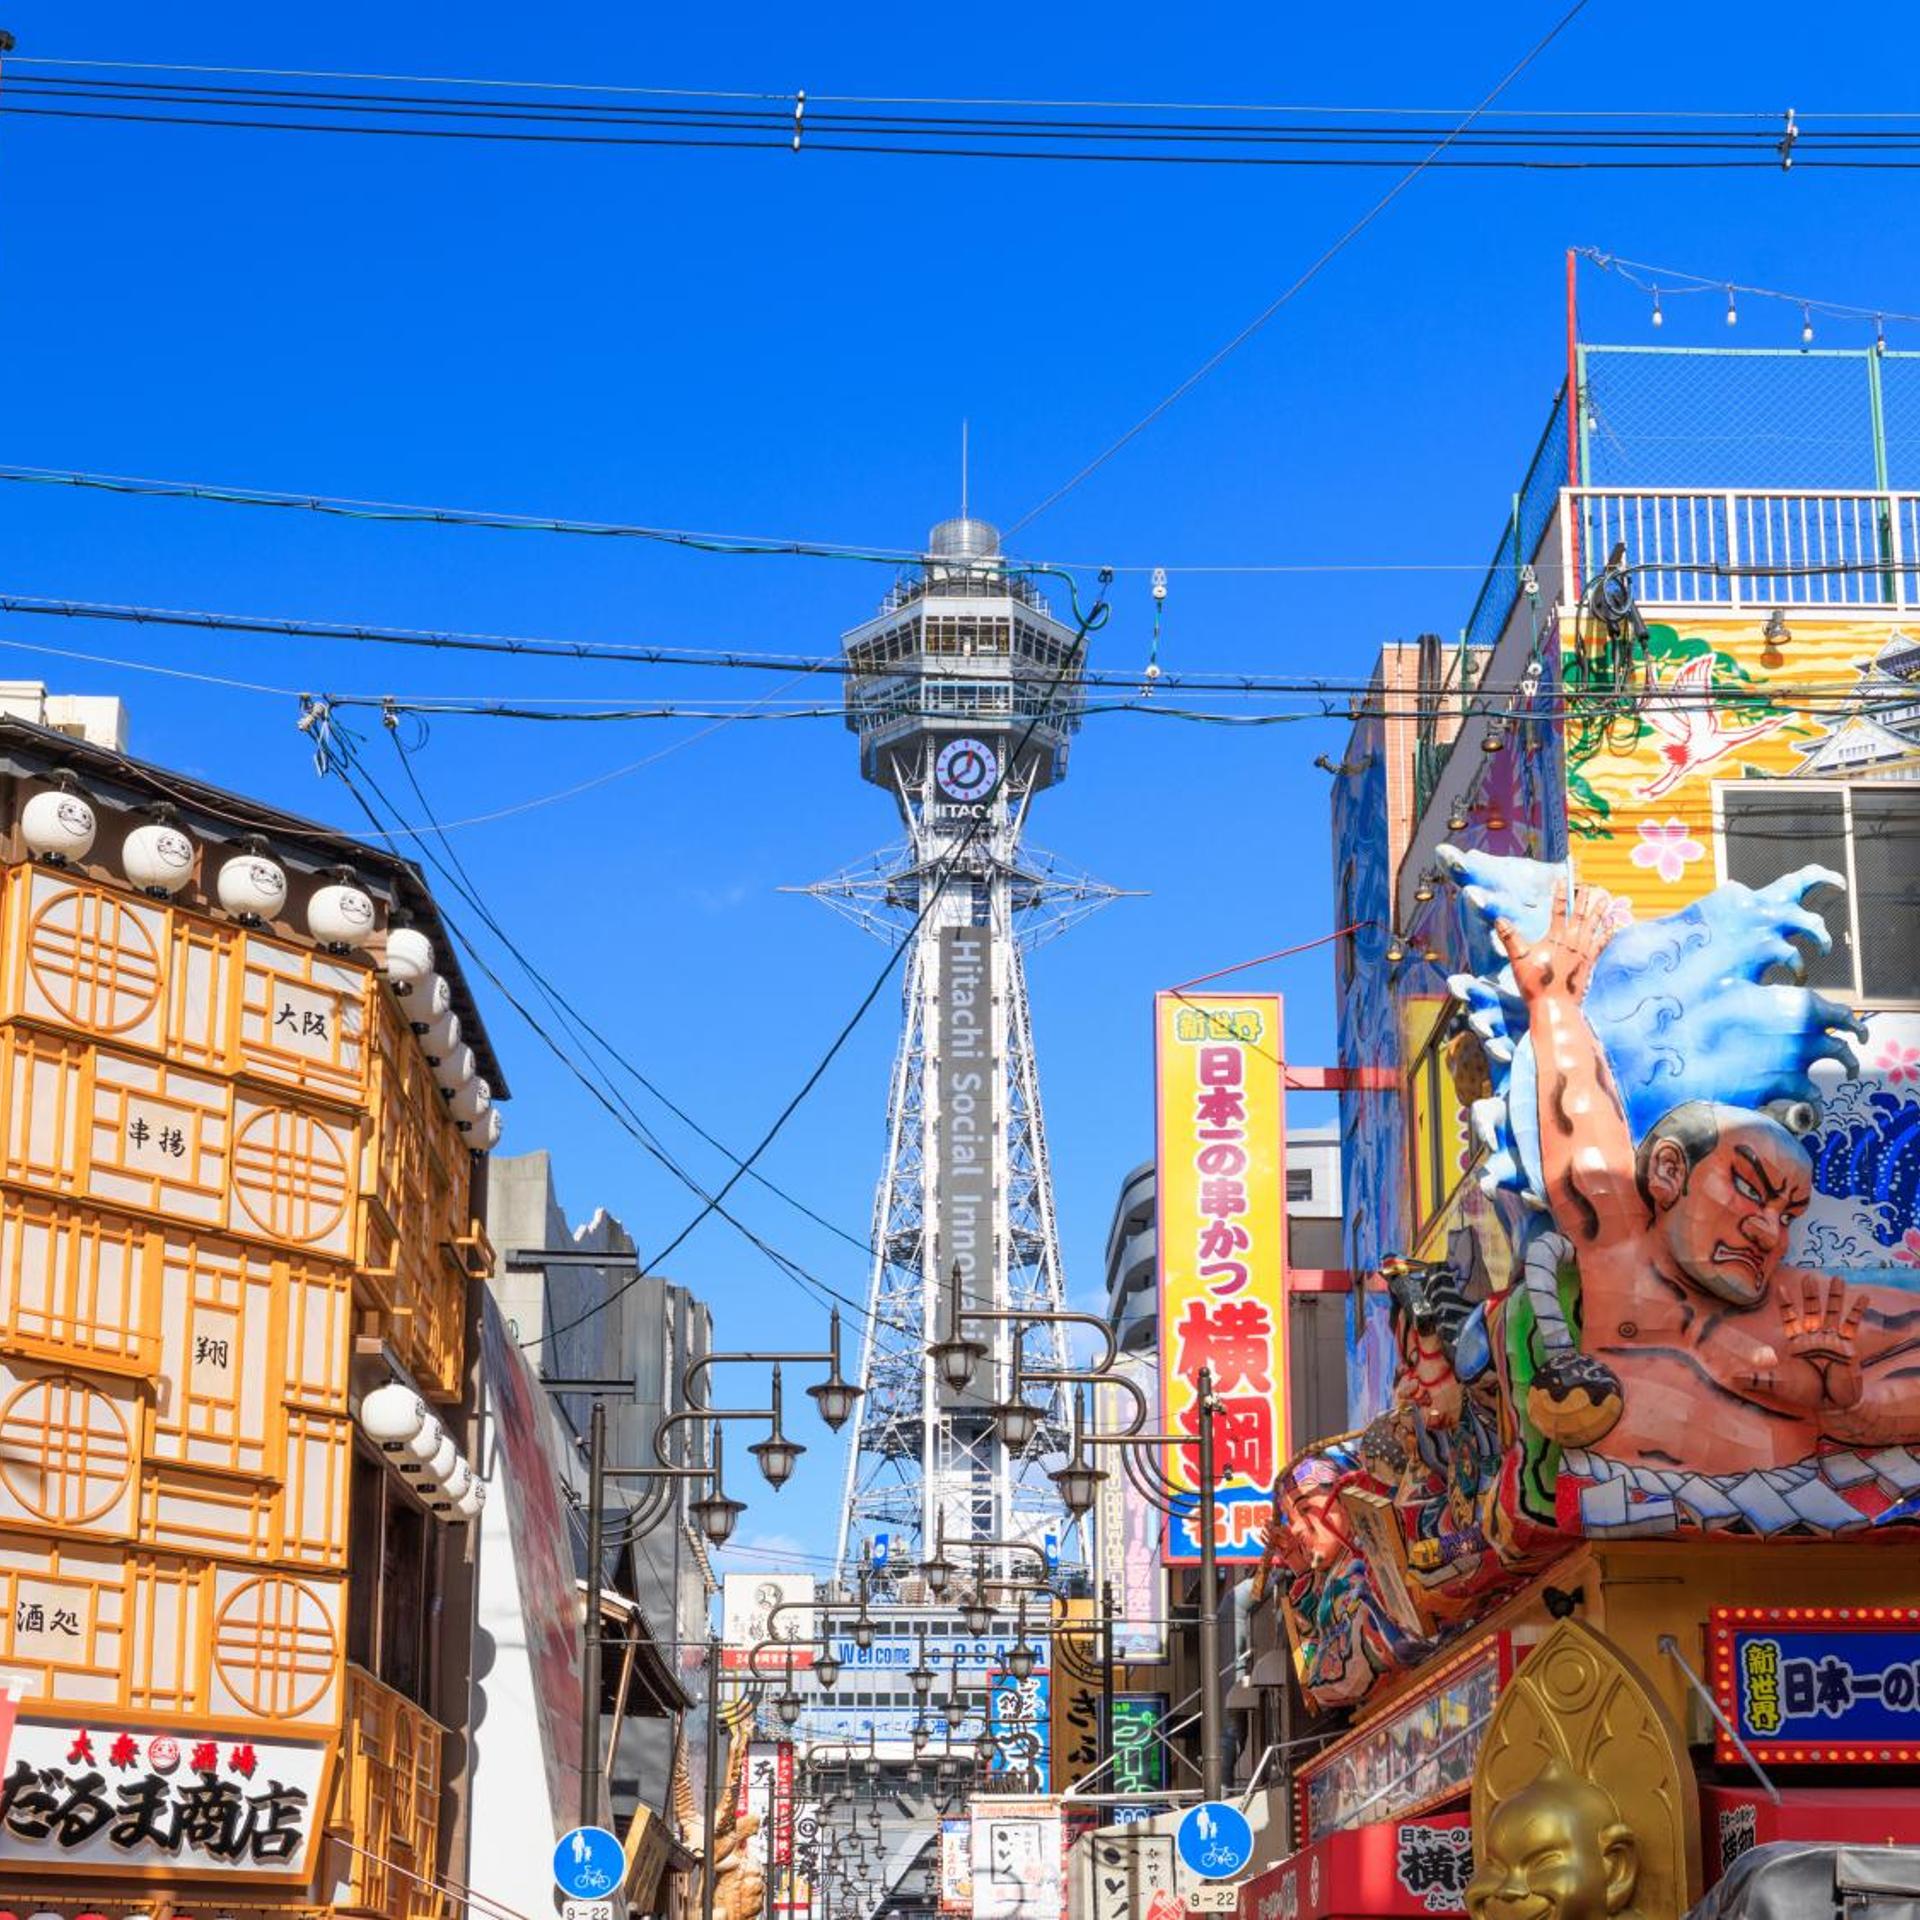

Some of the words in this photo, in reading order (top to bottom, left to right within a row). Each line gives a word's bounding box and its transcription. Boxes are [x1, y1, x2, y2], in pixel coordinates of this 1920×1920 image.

[275, 1003, 328, 1040] 大阪
[951, 941, 984, 1058] Hitachi
[1177, 1009, 1264, 1042] 新世界
[129, 1117, 186, 1157] 串揚
[951, 1072, 985, 1176] Social
[1196, 1047, 1249, 1295] 日本一の串かつ
[1177, 1300, 1273, 1488] 横綱
[17, 1602, 81, 1636] 酒処
[839, 1643, 910, 1665] Welcome
[953, 1643, 1045, 1664] OSAA
[1745, 1642, 1781, 1732] 新世界
[1784, 1659, 1920, 1714] 日本一の
[1, 1760, 308, 1862] だるま商店
[1402, 1829, 1473, 1844] 日本一の
